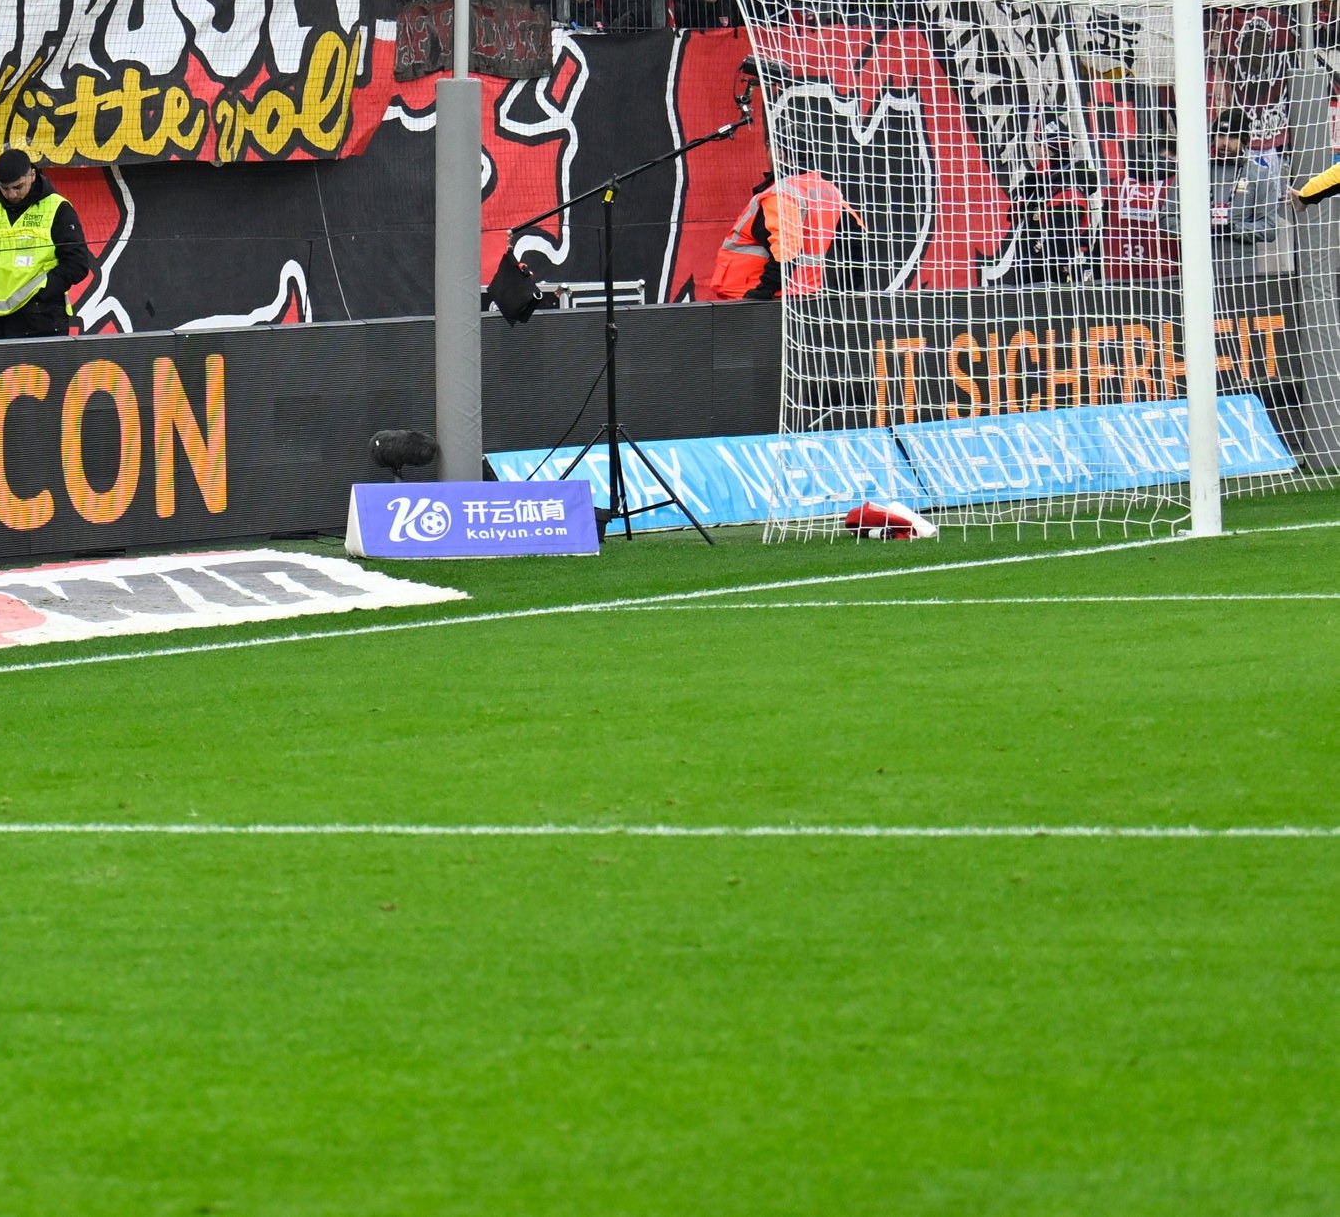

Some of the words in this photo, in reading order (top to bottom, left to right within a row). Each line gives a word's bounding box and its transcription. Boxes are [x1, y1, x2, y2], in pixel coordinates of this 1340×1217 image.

[875, 337, 928, 428] IT
[462, 498, 566, 524] 开云体育
[466, 526, 568, 541] kaiyun.com
